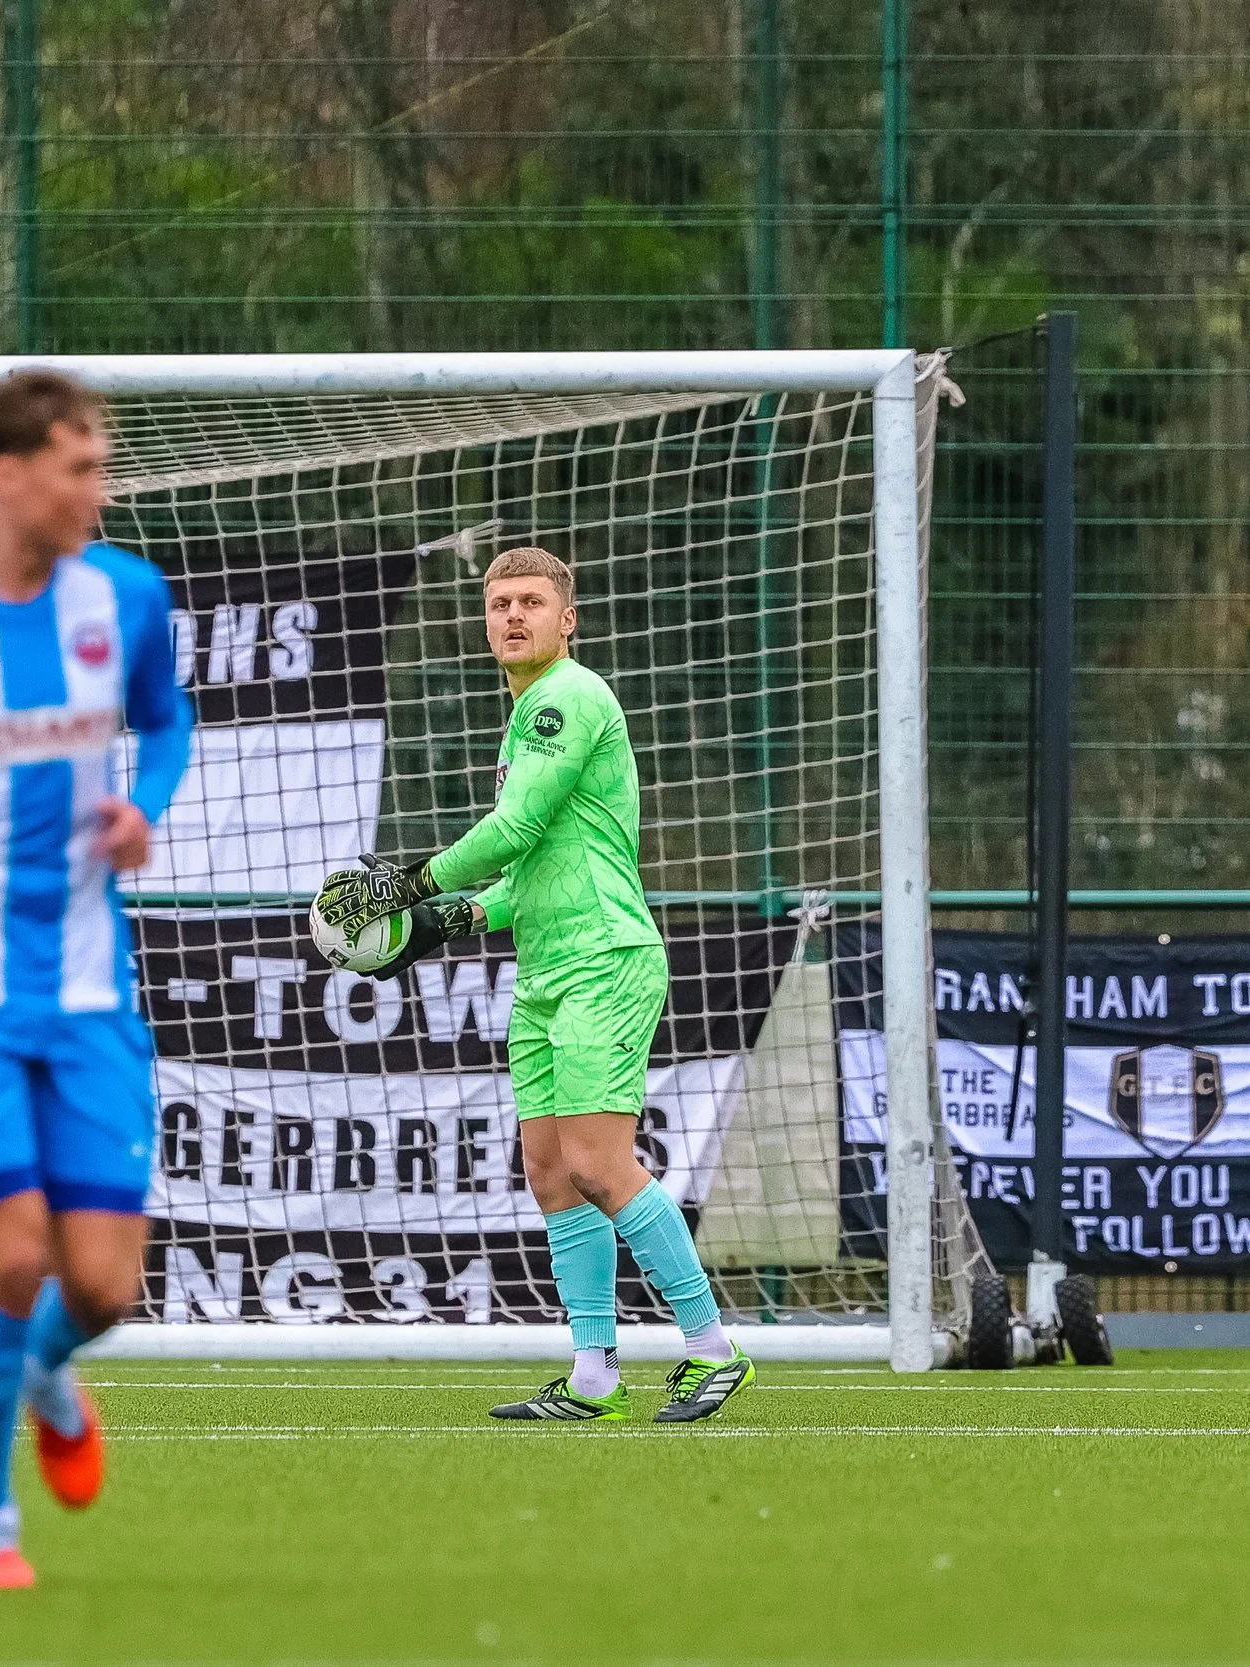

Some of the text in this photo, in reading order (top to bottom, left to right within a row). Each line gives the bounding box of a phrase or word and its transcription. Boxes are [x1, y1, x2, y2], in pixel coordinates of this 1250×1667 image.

[535, 715, 562, 731] DP's
[530, 745, 555, 758] SERVICES
[546, 741, 567, 754] ADVICE
[934, 968, 1168, 1019] RANHAM
[941, 1069, 997, 1095] THE
[1136, 1164, 1230, 1209] YOU
[1071, 1212, 1250, 1258] FOLLOW
[162, 1246, 493, 1325] NG31
